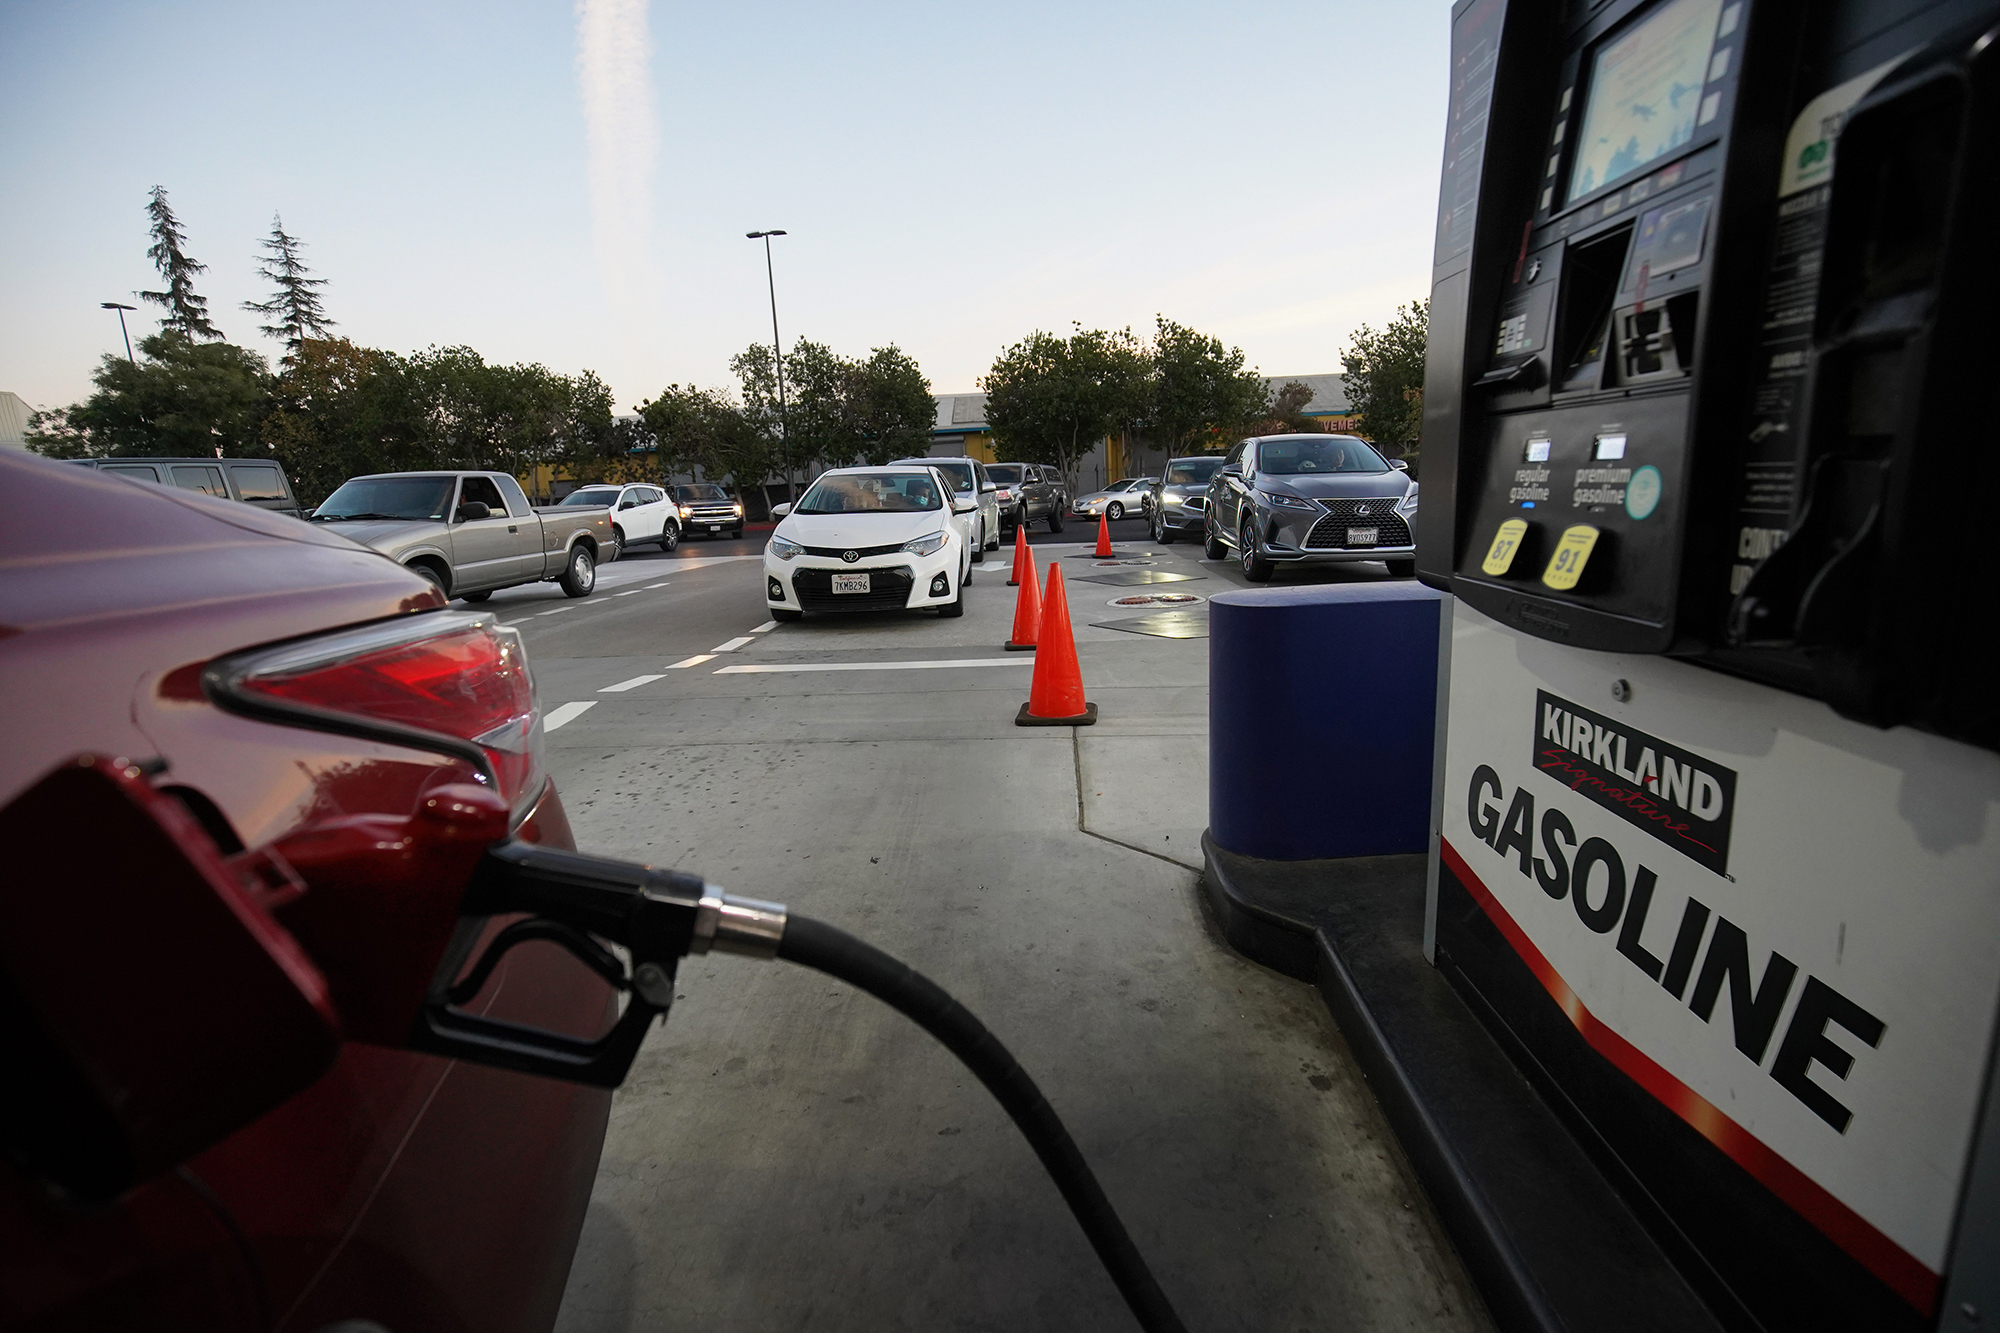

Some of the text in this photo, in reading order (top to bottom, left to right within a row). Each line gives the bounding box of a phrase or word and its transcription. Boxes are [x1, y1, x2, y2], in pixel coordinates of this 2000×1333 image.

[1515, 464, 1550, 486] regular
[1573, 463, 1632, 487] premium
[1509, 484, 1549, 503] gasoline
[1572, 484, 1625, 507] gasoline
[1492, 540, 1514, 561] 87
[1555, 548, 1580, 573] 91
[835, 581, 867, 590] 7KMB296
[1543, 702, 1724, 822] KIRKLAND
[1541, 748, 1718, 854] Signature
[1468, 764, 1887, 1136] GASOLINE
